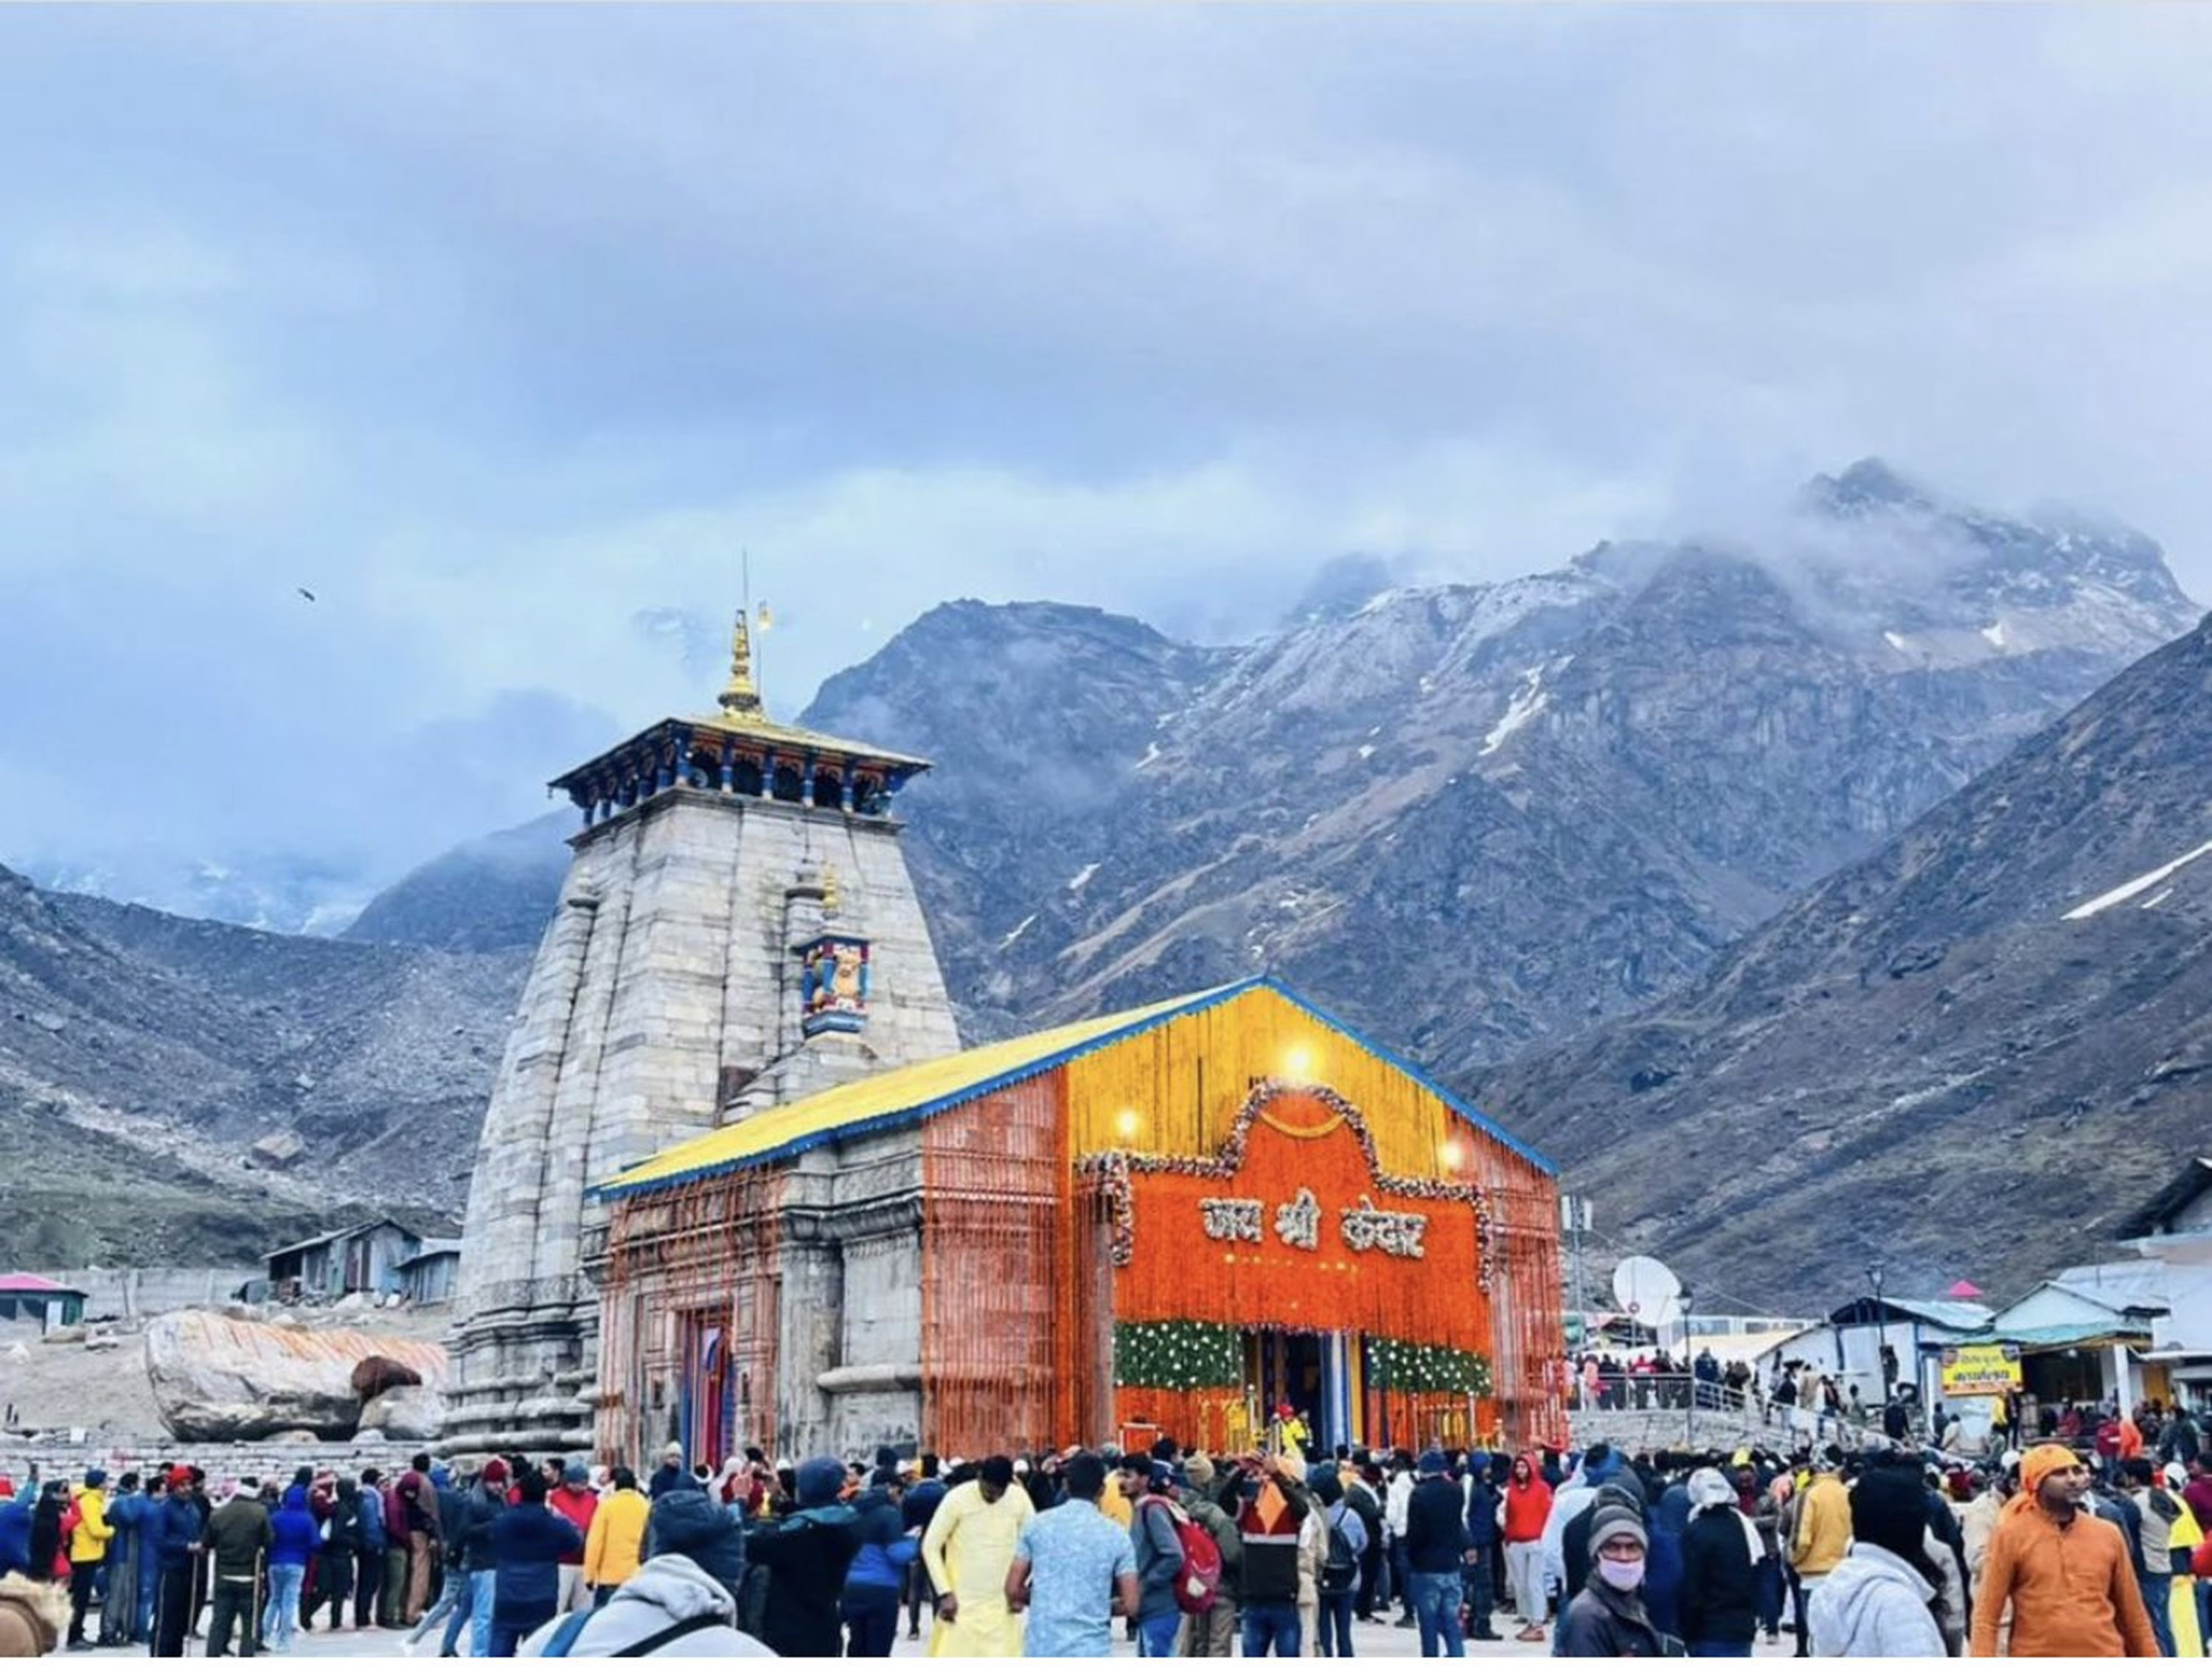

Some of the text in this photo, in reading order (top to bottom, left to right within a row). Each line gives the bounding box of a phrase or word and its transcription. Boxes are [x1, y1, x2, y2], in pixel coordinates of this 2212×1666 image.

[1198, 1185, 1429, 1258] जय श्री केदार
